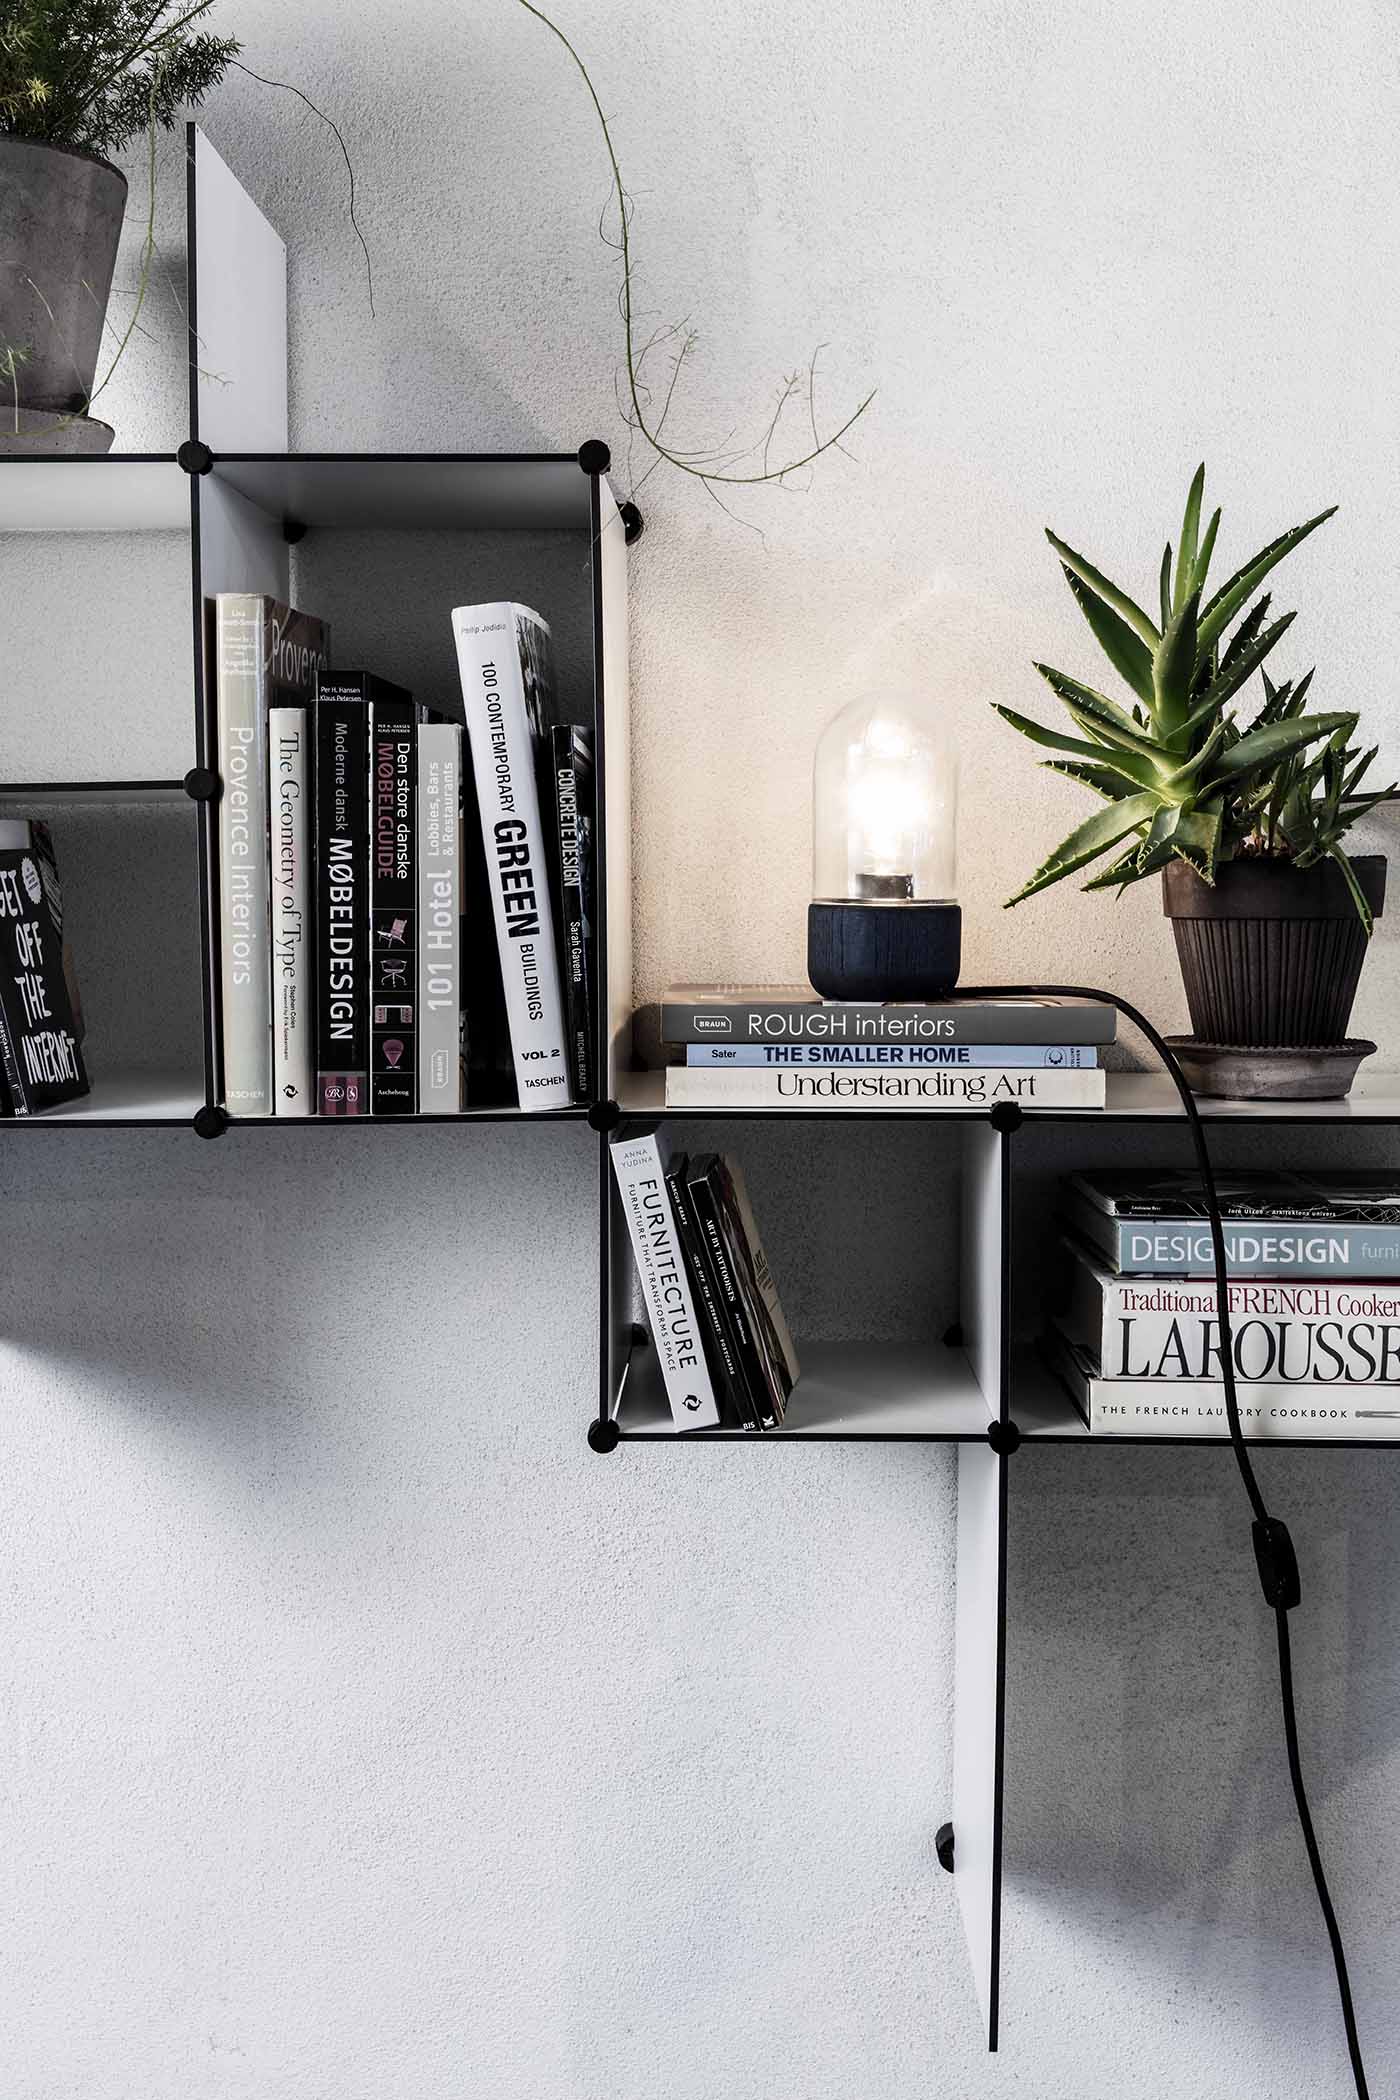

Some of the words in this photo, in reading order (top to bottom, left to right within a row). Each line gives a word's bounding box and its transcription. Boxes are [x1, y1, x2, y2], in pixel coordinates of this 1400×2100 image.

[481, 661, 498, 687] 100
[279, 731, 300, 773] The
[335, 723, 348, 785] Moderne
[397, 743, 410, 774] Den
[486, 692, 516, 813] CONTEMPORARY
[230, 727, 254, 857] Provence
[397, 779, 410, 817] store
[427, 762, 439, 794] Bars
[335, 788, 348, 831] dansk
[377, 743, 394, 879] MØBELGUIDE
[442, 762, 454, 842] Restaurants
[558, 769, 577, 837] CONCRETE
[275, 780, 300, 889] Geometry
[427, 798, 440, 856] Lobbies,
[397, 824, 410, 880] danske
[442, 846, 454, 856] &
[562, 840, 580, 886] DESIGN
[494, 819, 540, 938] GREEN
[231, 865, 256, 985] Interiors
[281, 898, 302, 919] of
[427, 870, 453, 949] Hotel
[15, 921, 43, 968] OFF
[275, 923, 302, 978] Type
[328, 838, 354, 1039] MØBELDESIGN
[570, 921, 581, 947] Sarah
[520, 943, 543, 1020] BUILDINGS
[571, 947, 582, 983] Gaventa
[14, 972, 52, 1028] THE
[289, 985, 297, 1010] Stephen
[427, 963, 453, 1010] 101
[749, 1014, 846, 1036] ROUGH
[856, 1014, 955, 1036] interiors
[21, 1029, 80, 1085] INTERNET
[521, 1050, 547, 1061] VOL
[550, 1049, 560, 1058] 2
[577, 1031, 585, 1063] MITCHELL
[711, 1049, 737, 1059] Sater
[763, 1047, 803, 1062] THE
[808, 1047, 904, 1063] SMALLER
[909, 1047, 970, 1063] HOME
[378, 1089, 410, 1097] Aschehoug
[524, 1075, 565, 1088] TASCHEN
[777, 1072, 986, 1102] Understanding
[991, 1074, 1037, 1096] Art
[622, 1156, 653, 1168] YUDINA
[624, 1149, 648, 1159] ANNA
[628, 1183, 647, 1240] FURNITURE
[705, 1218, 717, 1237] ART
[641, 1243, 654, 1268] THAT
[711, 1237, 721, 1251] BY
[639, 1179, 698, 1369] FURNITECTURE
[714, 1250, 736, 1303] TATTOOISTS
[647, 1271, 669, 1337] TRANSFORMS
[1228, 1288, 1331, 1316] FRENCH
[663, 1341, 676, 1371] SPACE
[1116, 1317, 1400, 1382] LAROUSSE
[743, 1421, 756, 1431] BIS
[1101, 1406, 1126, 1415] THE
[1136, 1406, 1189, 1416] FRENCH
[1198, 1406, 1262, 1417] LAUDRY
[1270, 1408, 1348, 1418] COOKBOOK
